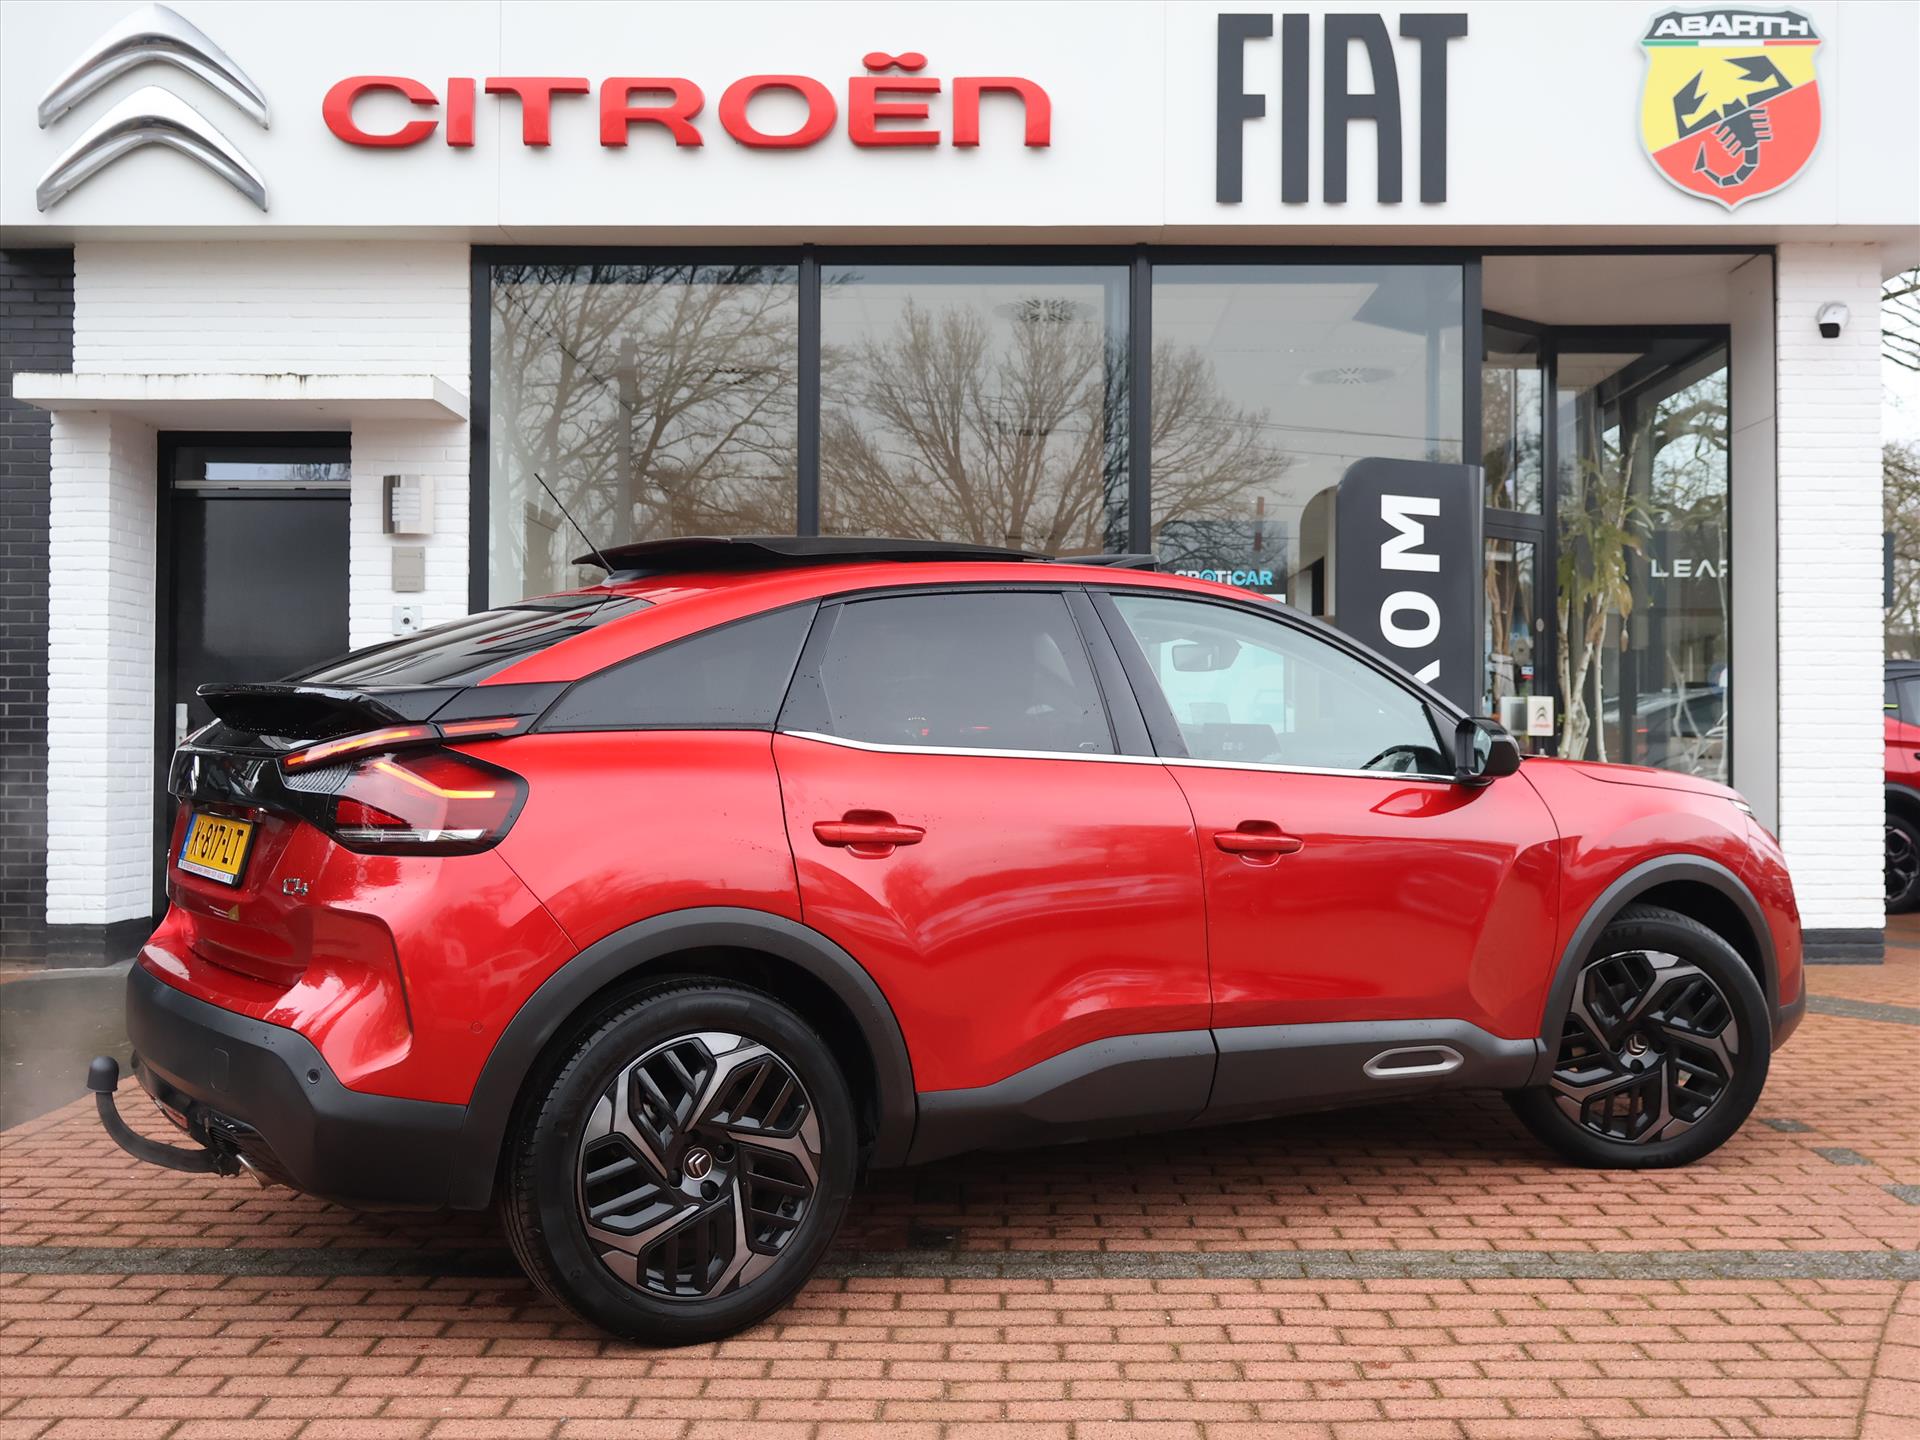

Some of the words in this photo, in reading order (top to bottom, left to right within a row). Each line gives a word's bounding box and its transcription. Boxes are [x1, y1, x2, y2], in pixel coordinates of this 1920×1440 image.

[1654, 14, 1809, 37] ABARTH
[322, 52, 1052, 149] CITROËN
[1217, 13, 1468, 204] FIAT
[190, 820, 245, 866] K-817-LT
